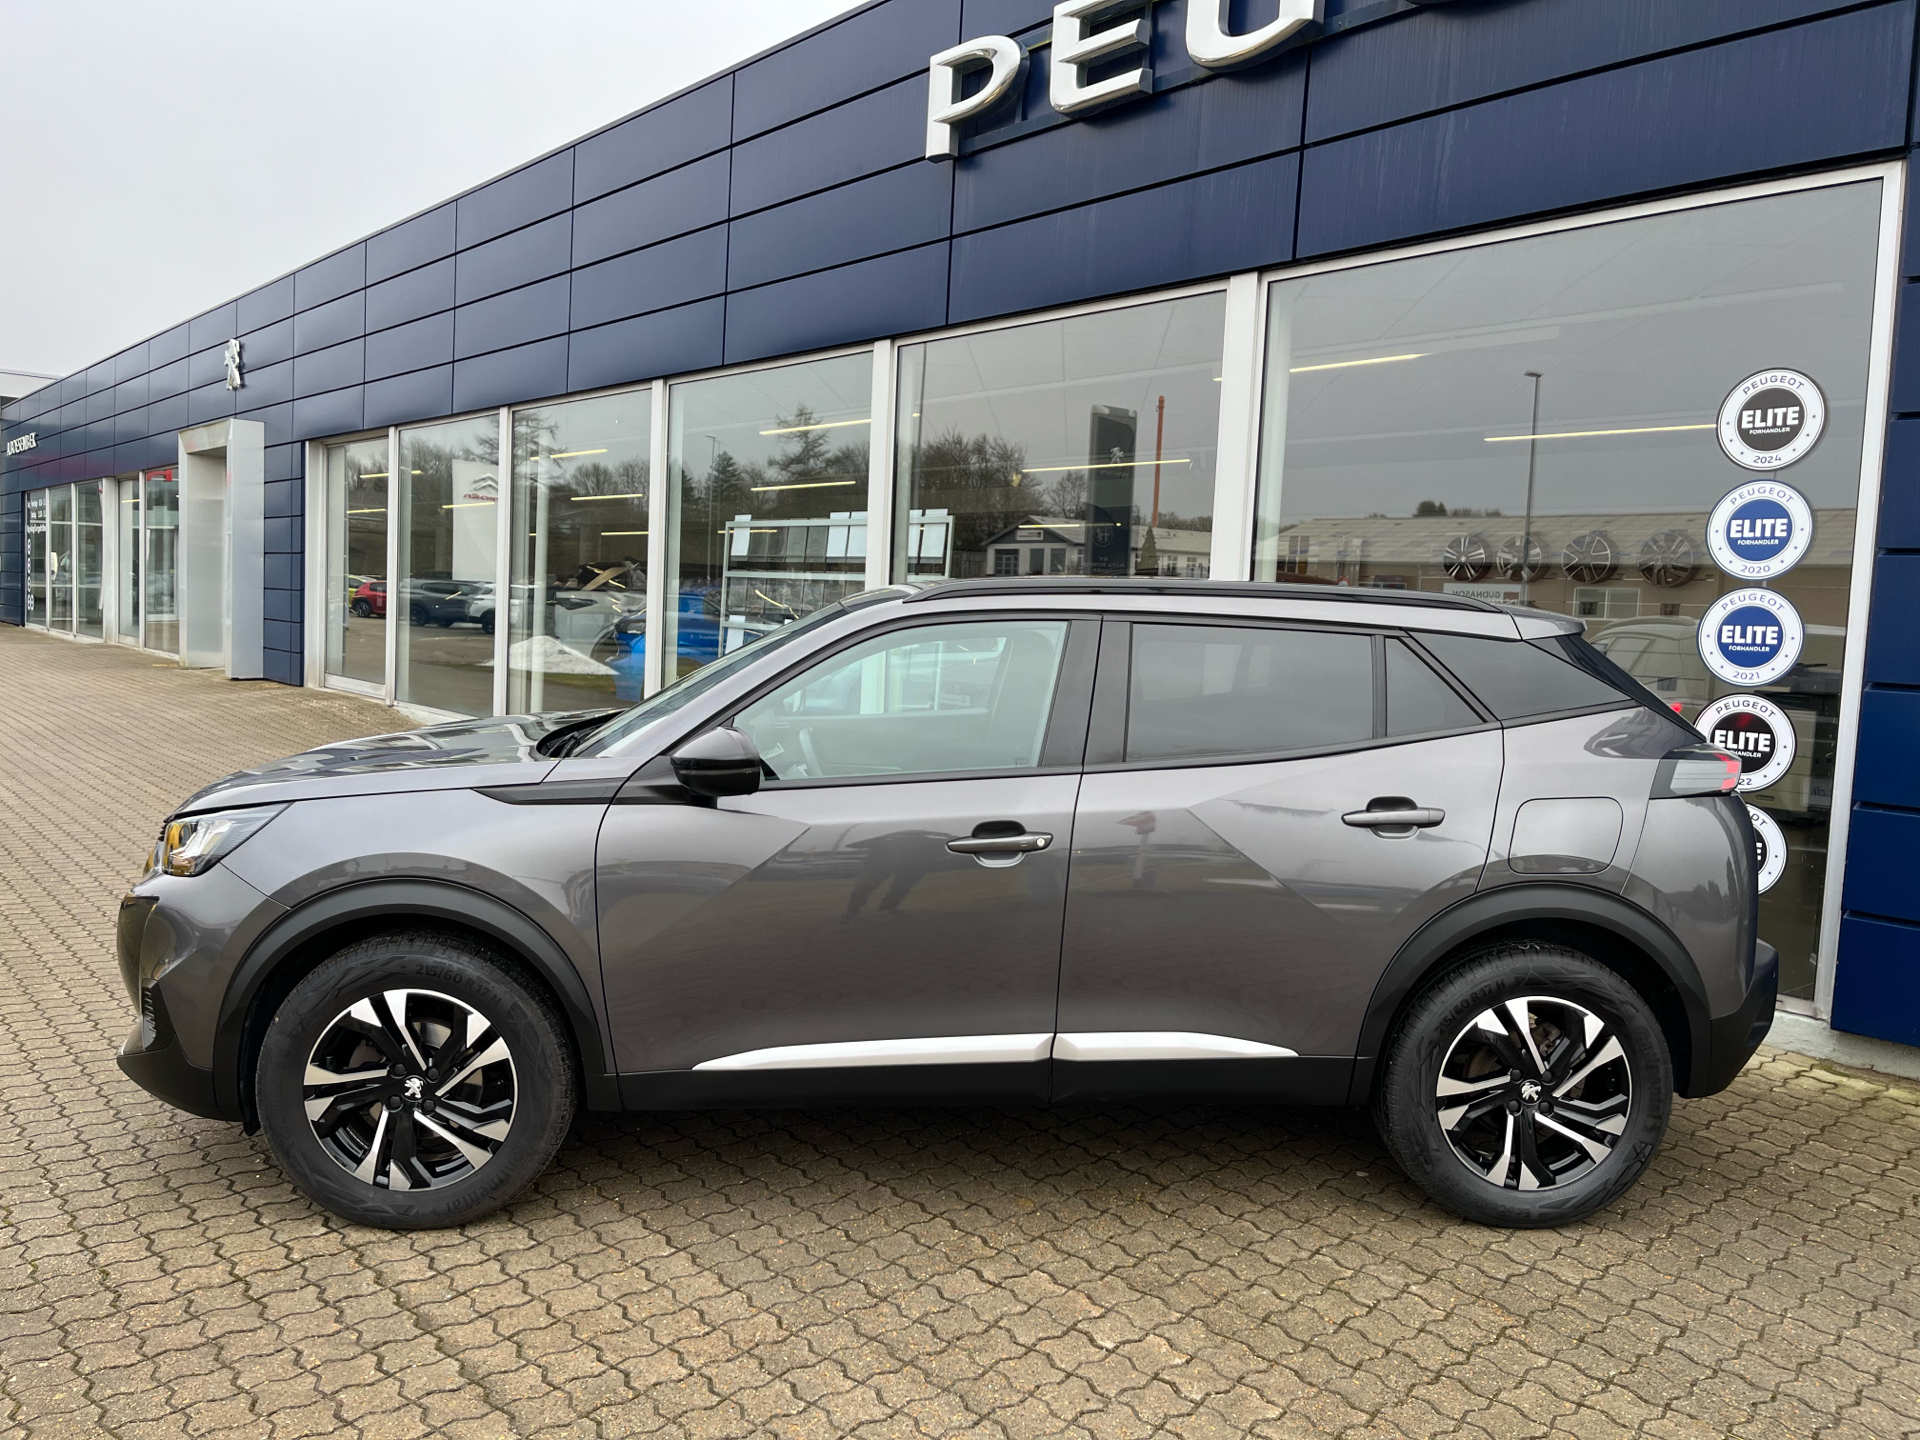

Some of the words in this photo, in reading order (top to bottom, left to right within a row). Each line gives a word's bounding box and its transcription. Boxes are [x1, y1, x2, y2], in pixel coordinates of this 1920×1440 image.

[1742, 375, 1805, 395] PEUGEOT
[1741, 406, 1800, 429] ELITE
[1749, 427, 1790, 435] FORHANDLER
[1752, 454, 1782, 464] 2024
[1730, 486, 1795, 506] PEUGEOT
[1729, 517, 1789, 538] ELITE
[1740, 564, 1771, 574] 2020
[1721, 593, 1785, 612] PEUGEOT
[1721, 625, 1779, 645] ELITE
[1733, 671, 1760, 681] 2021
[1715, 699, 1776, 718] PEUGEOT
[1713, 729, 1771, 752] ELITE
[1738, 778, 1752, 786] 22
[415, 964, 463, 984] 215/60
[465, 978, 475, 989] R
[1435, 999, 1470, 1036] 215/60
